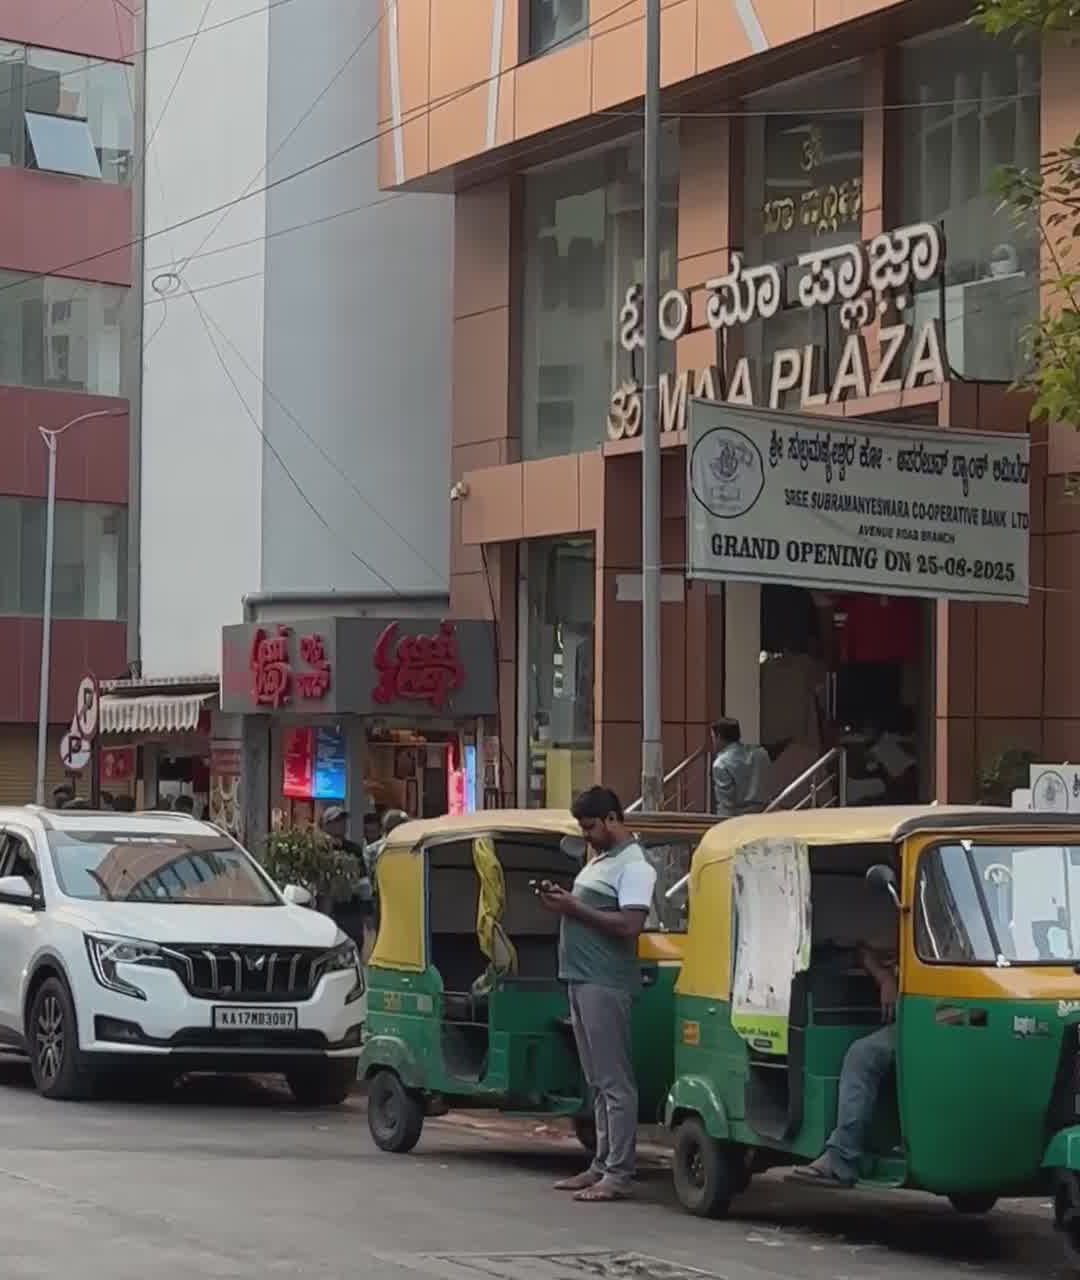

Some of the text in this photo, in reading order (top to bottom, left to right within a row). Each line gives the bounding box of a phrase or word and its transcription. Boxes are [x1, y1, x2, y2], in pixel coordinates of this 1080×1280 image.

[770, 316, 948, 410] PLAZA
[785, 489, 808, 508] SREE
[811, 491, 910, 520] SUBRAMANYESWARA
[912, 501, 978, 526] CO-OPERATIVE
[981, 508, 1007, 528] BANK
[858, 525, 955, 544] AVENUE ROAD BRANCH
[711, 533, 1015, 582] GRAND OPENING ON 25-08-2025
